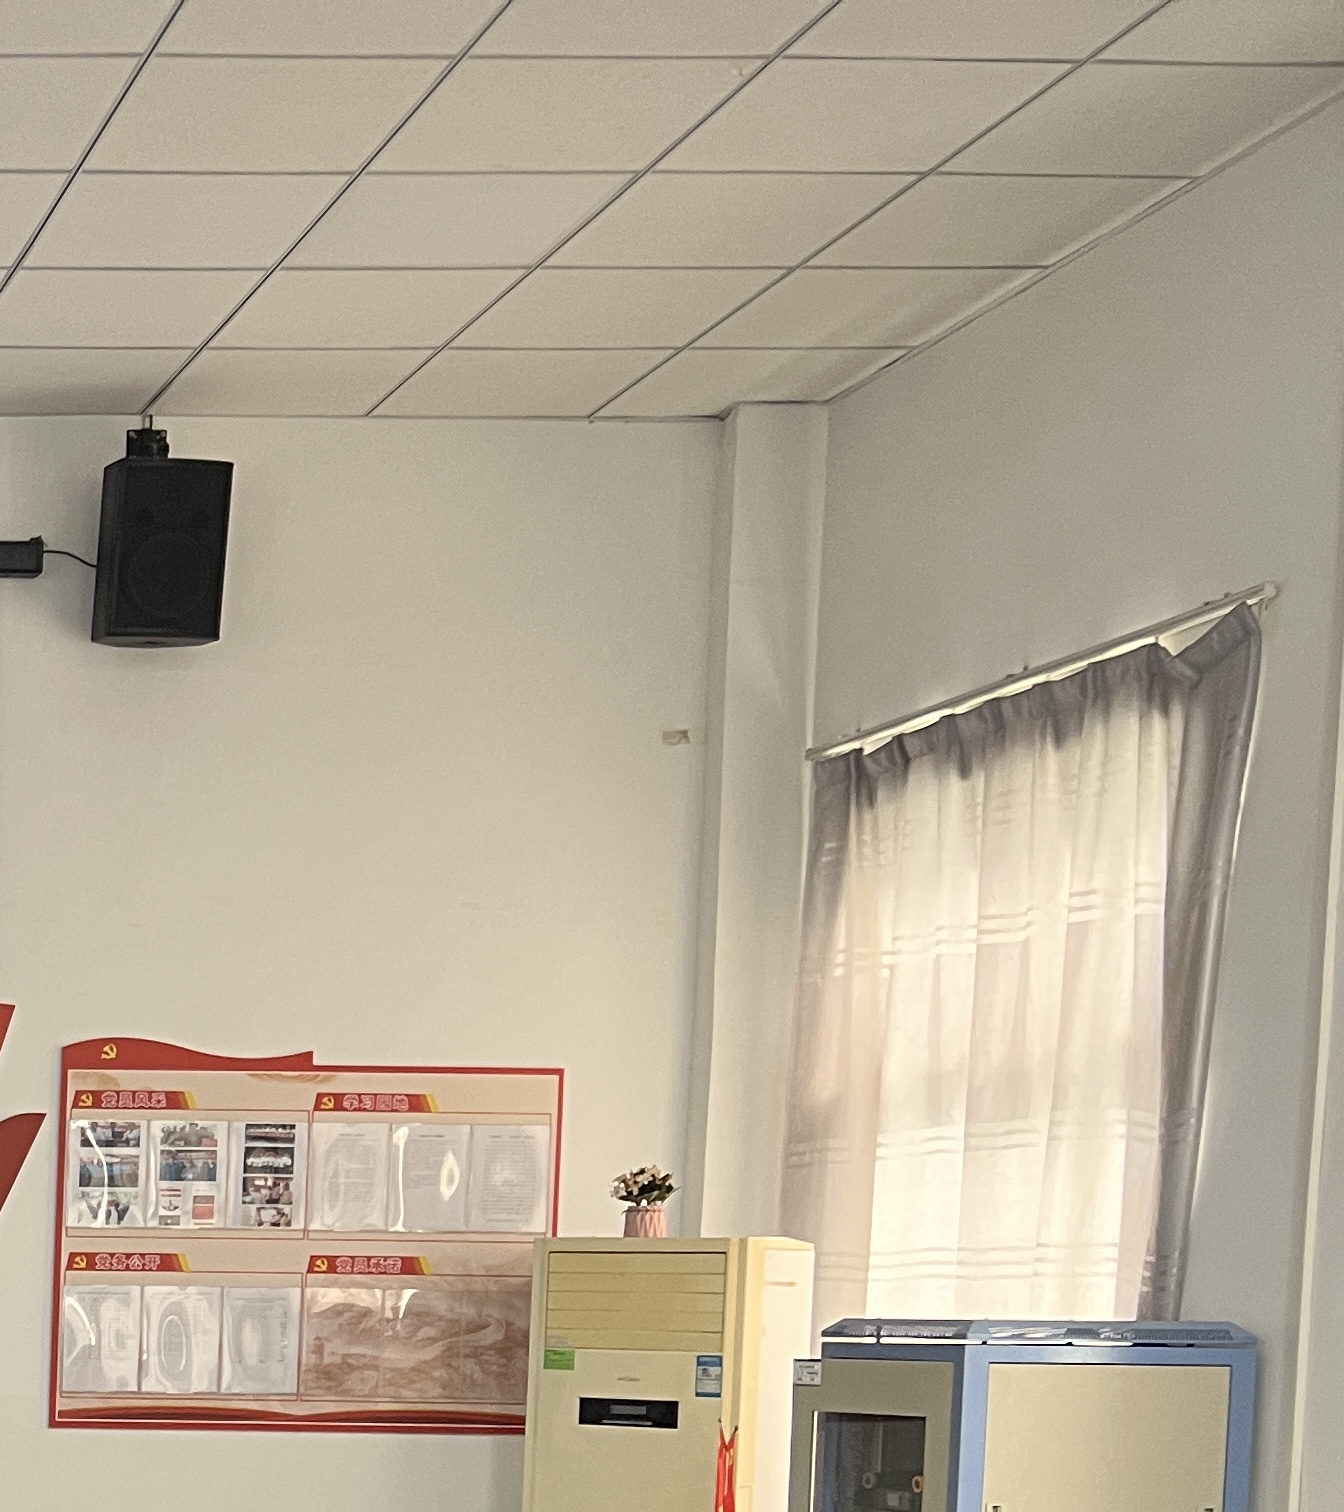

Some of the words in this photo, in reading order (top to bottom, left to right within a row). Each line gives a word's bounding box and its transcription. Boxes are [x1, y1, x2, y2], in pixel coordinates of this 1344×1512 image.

[101, 1092, 167, 1109] 党员风采
[342, 1094, 409, 1111] 学习园地
[94, 1254, 161, 1271] 党务公开
[335, 1256, 402, 1273] 党员承诺
